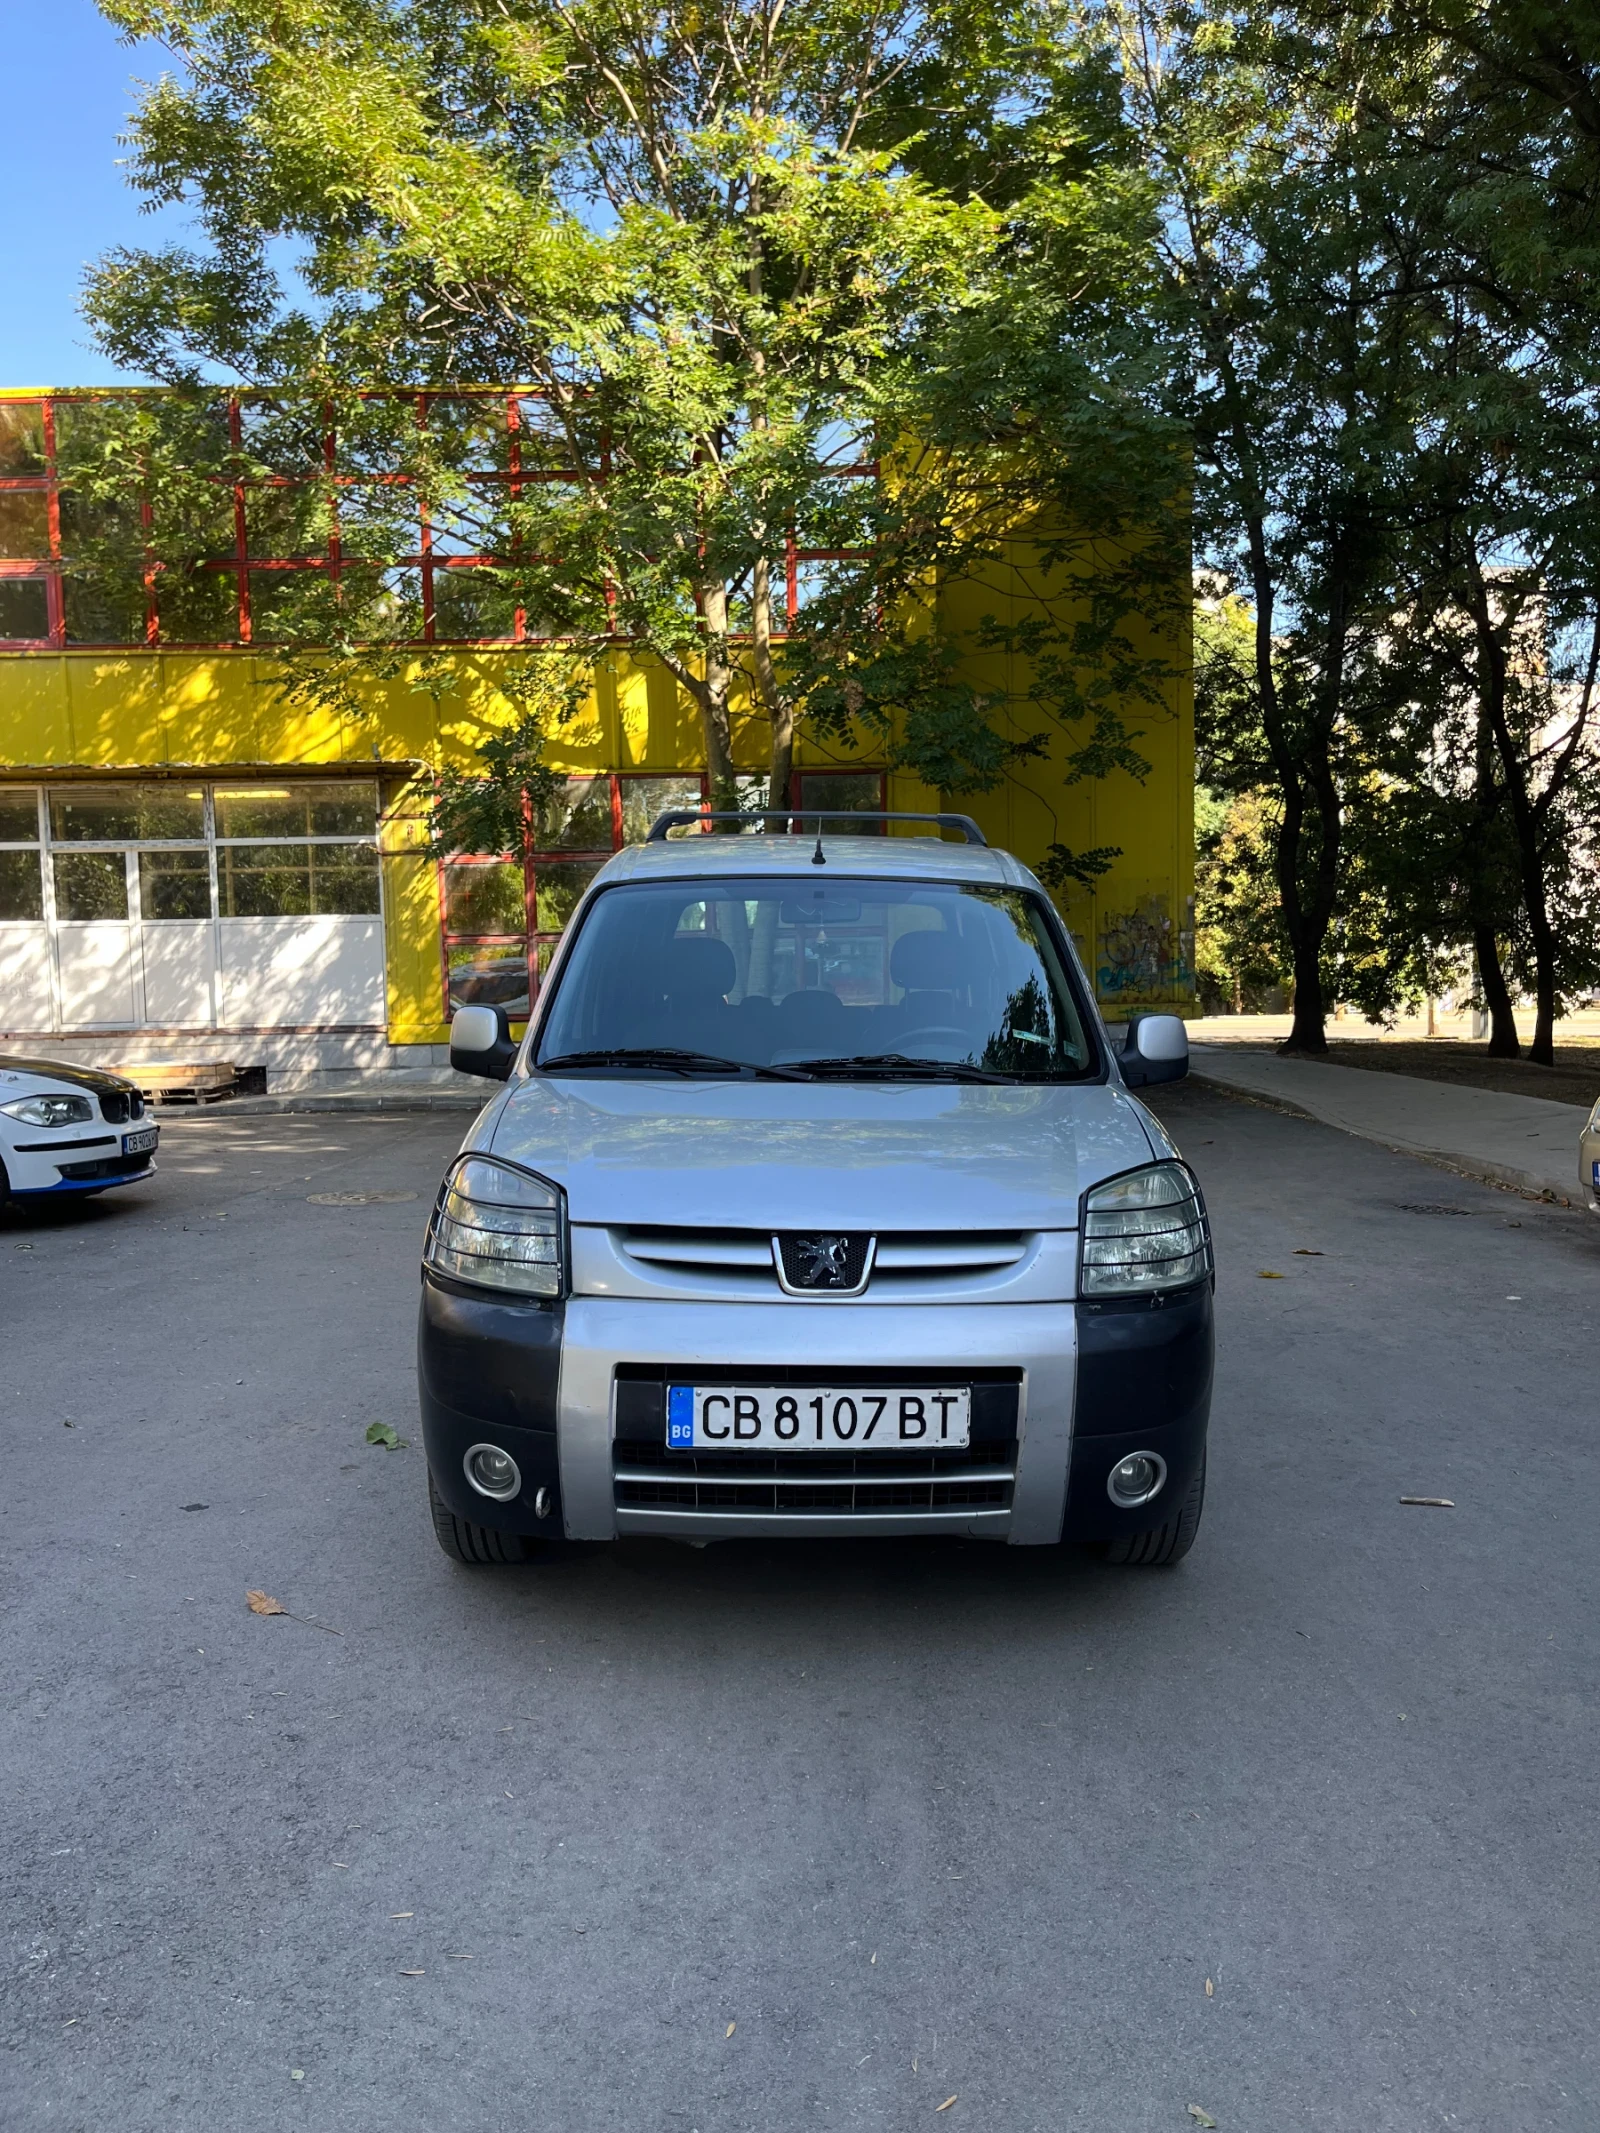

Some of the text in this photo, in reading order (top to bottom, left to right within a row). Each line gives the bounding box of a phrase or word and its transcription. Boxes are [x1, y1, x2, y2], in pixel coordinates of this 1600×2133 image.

[672, 1424, 691, 1439] BG
[702, 1395, 959, 1440] CB 8107 BT
